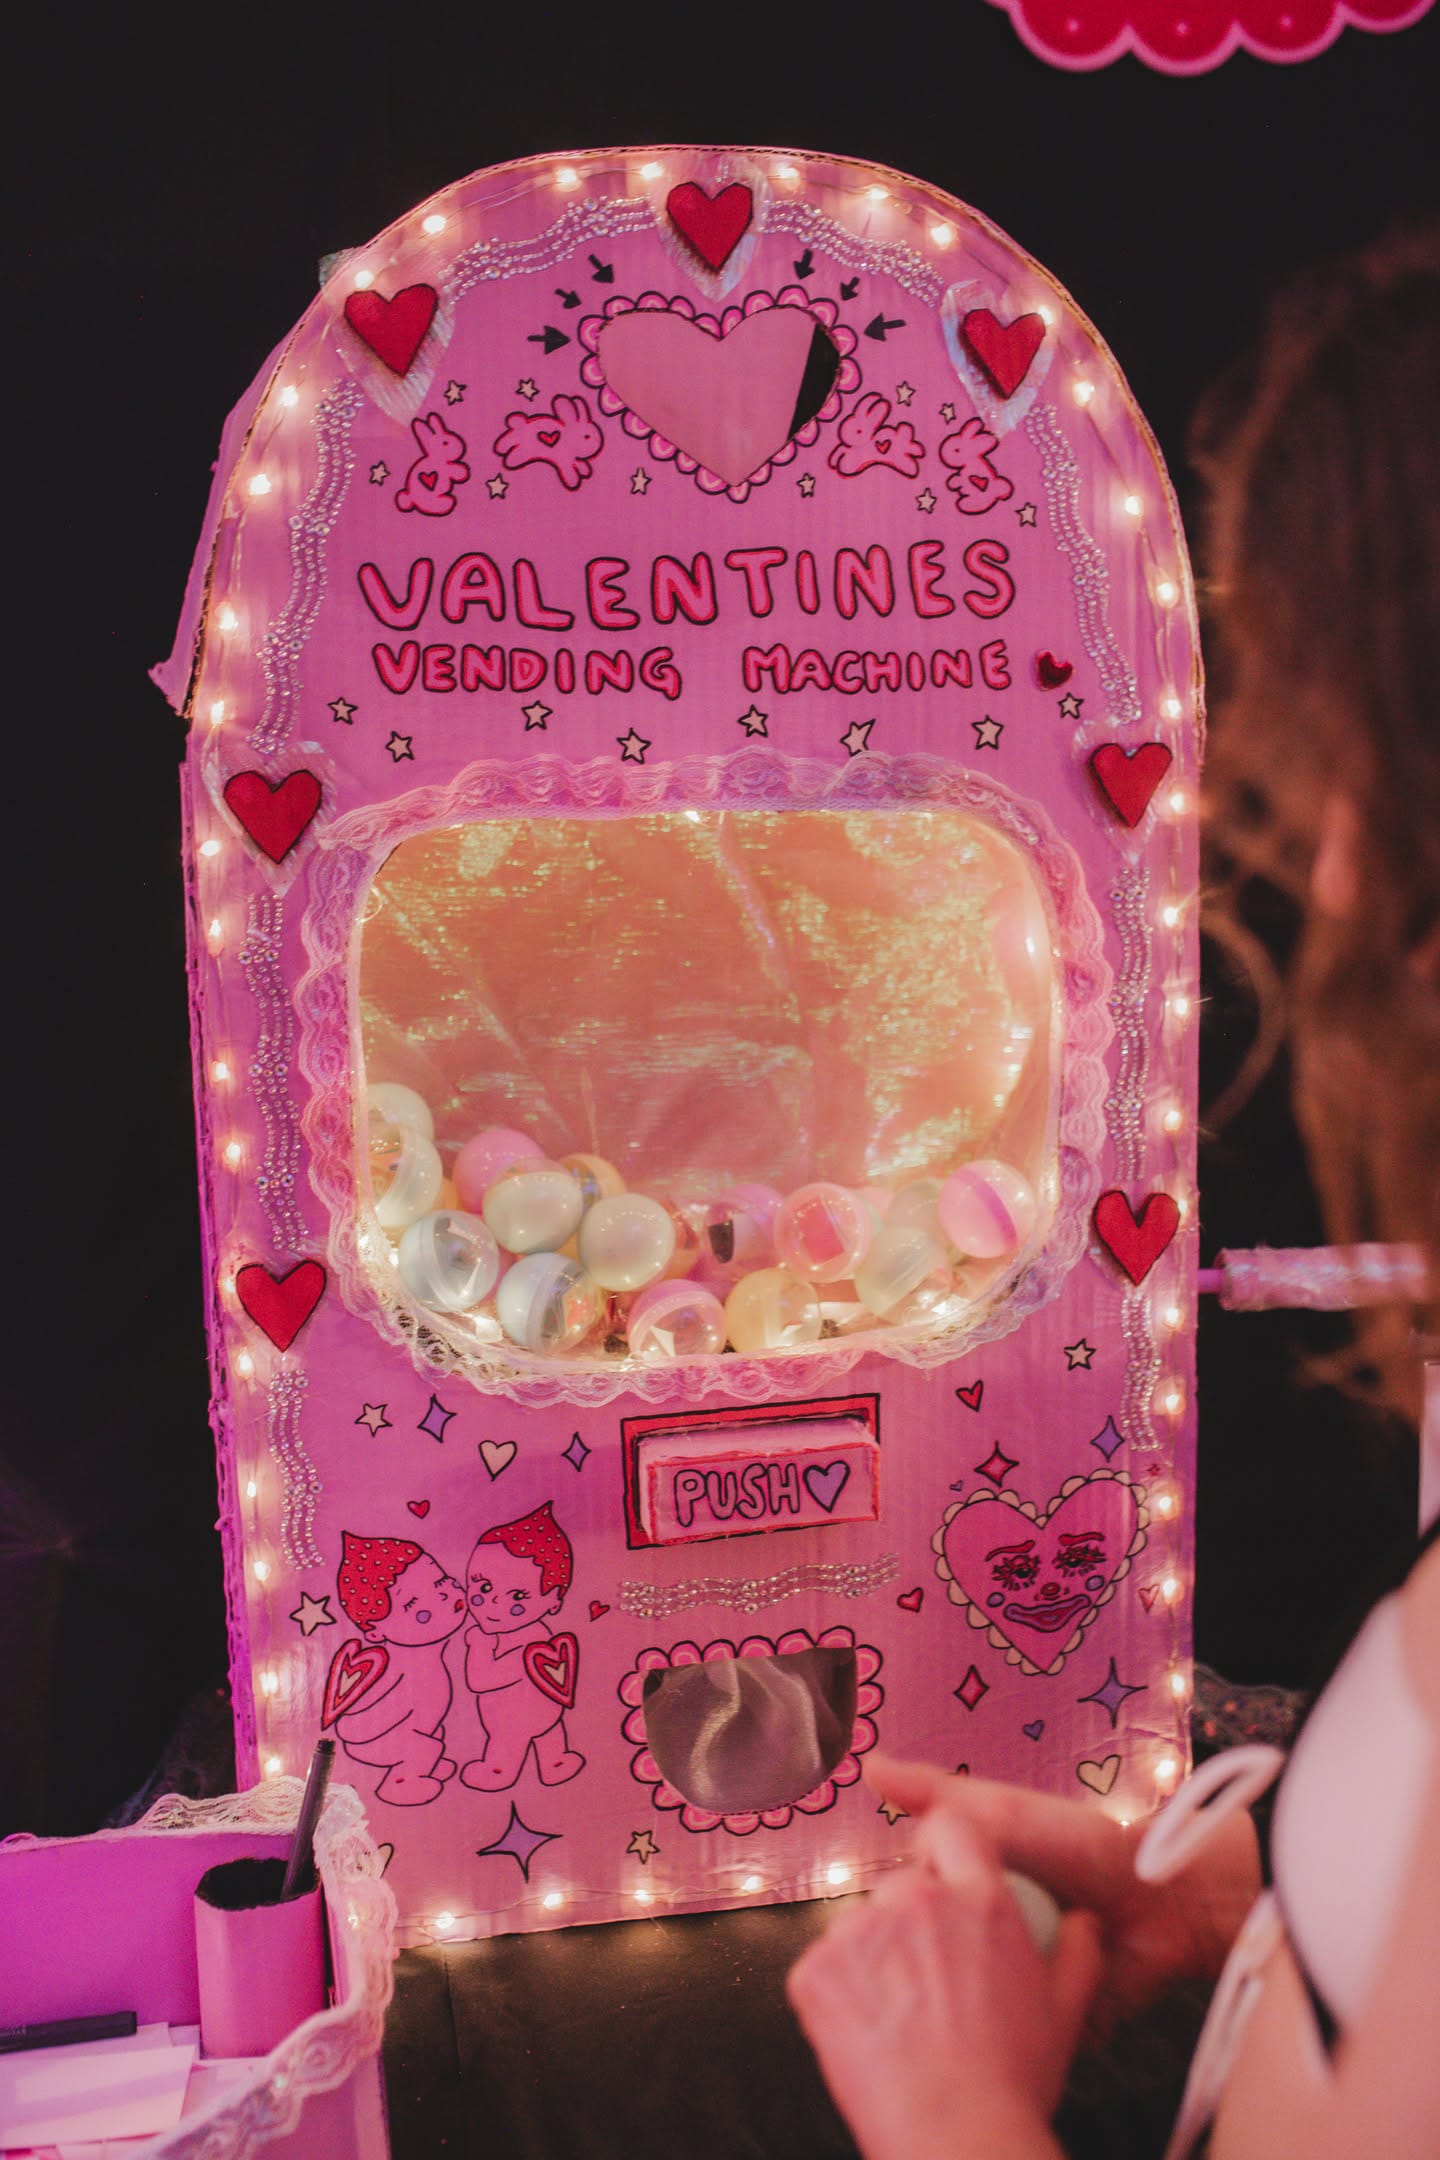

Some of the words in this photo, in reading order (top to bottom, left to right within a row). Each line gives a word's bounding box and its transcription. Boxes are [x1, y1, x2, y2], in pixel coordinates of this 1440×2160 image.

[358, 539, 1016, 631] VALENTINES
[372, 641, 681, 699] VENDING
[743, 640, 1011, 694] MACHINE
[674, 1463, 800, 1527] PUSH
